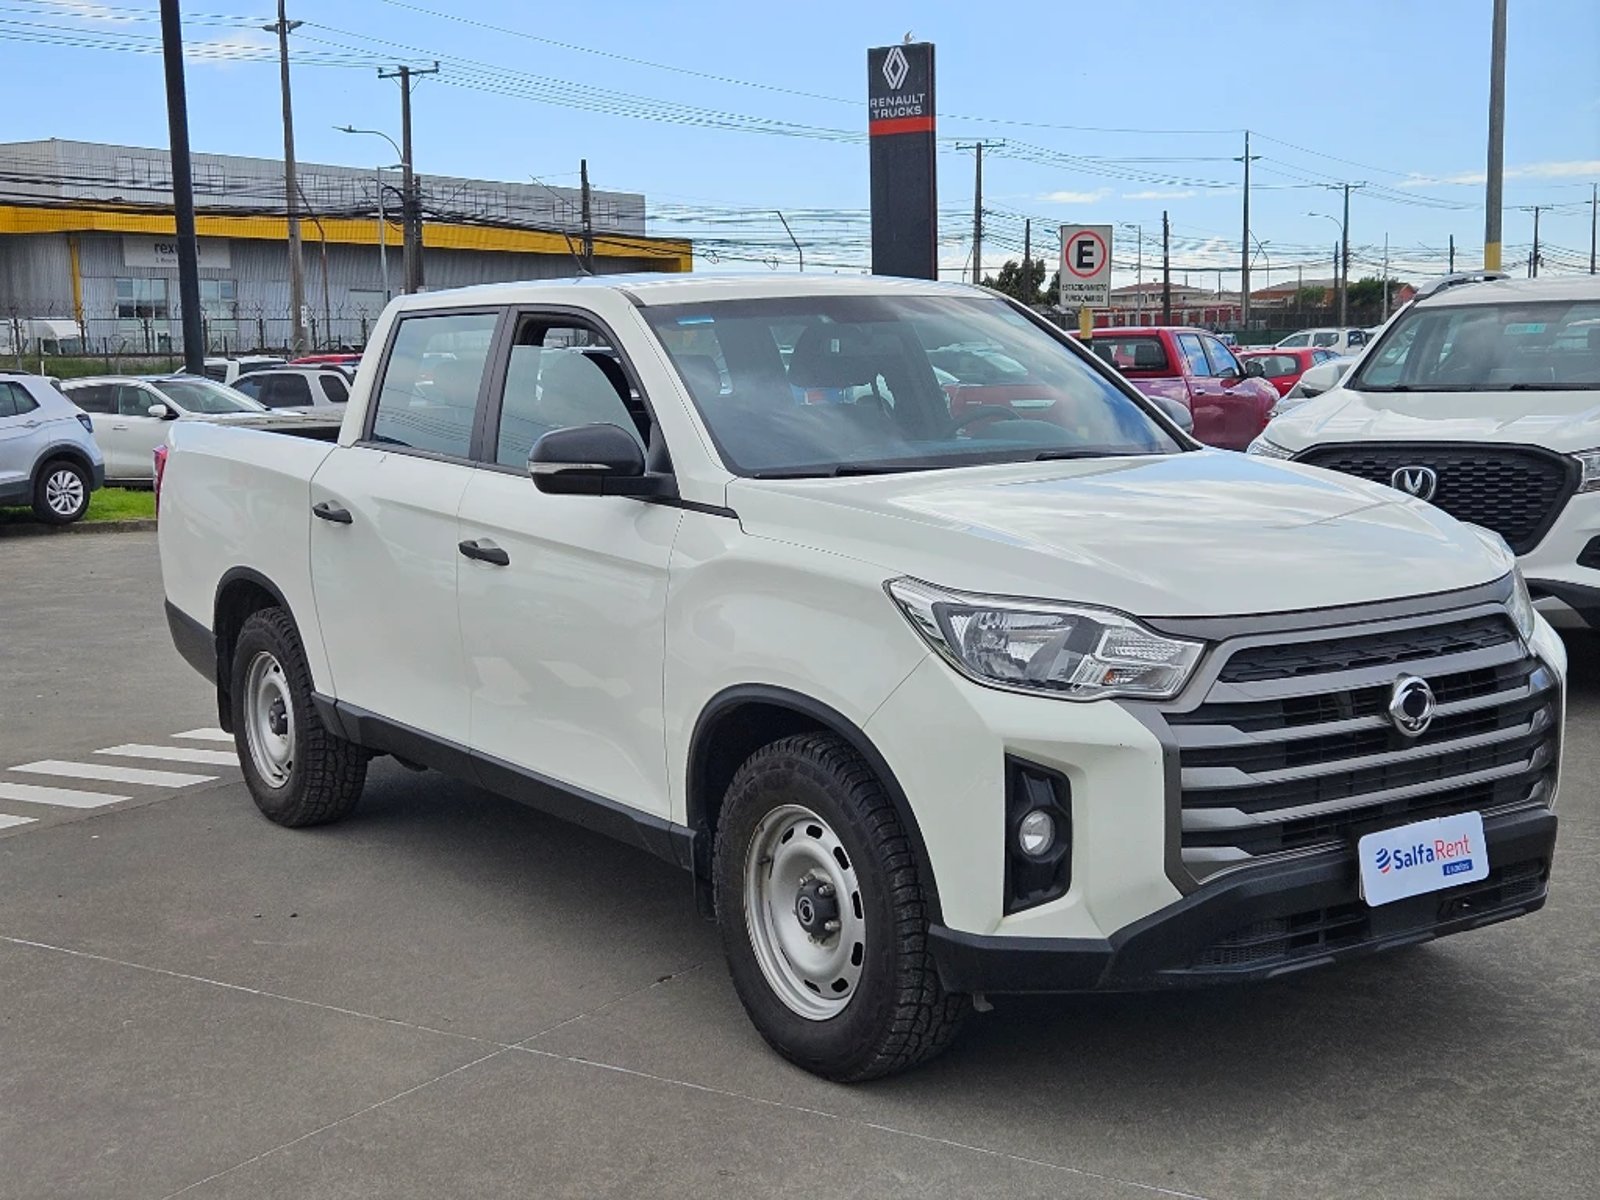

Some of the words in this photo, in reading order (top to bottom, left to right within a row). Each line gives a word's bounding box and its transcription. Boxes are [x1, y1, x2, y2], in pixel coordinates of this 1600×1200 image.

[870, 93, 925, 108] RENAULT
[873, 105, 922, 119] TRUCKS
[1077, 240, 1094, 269] E
[1393, 834, 1472, 870] SalfaRent
